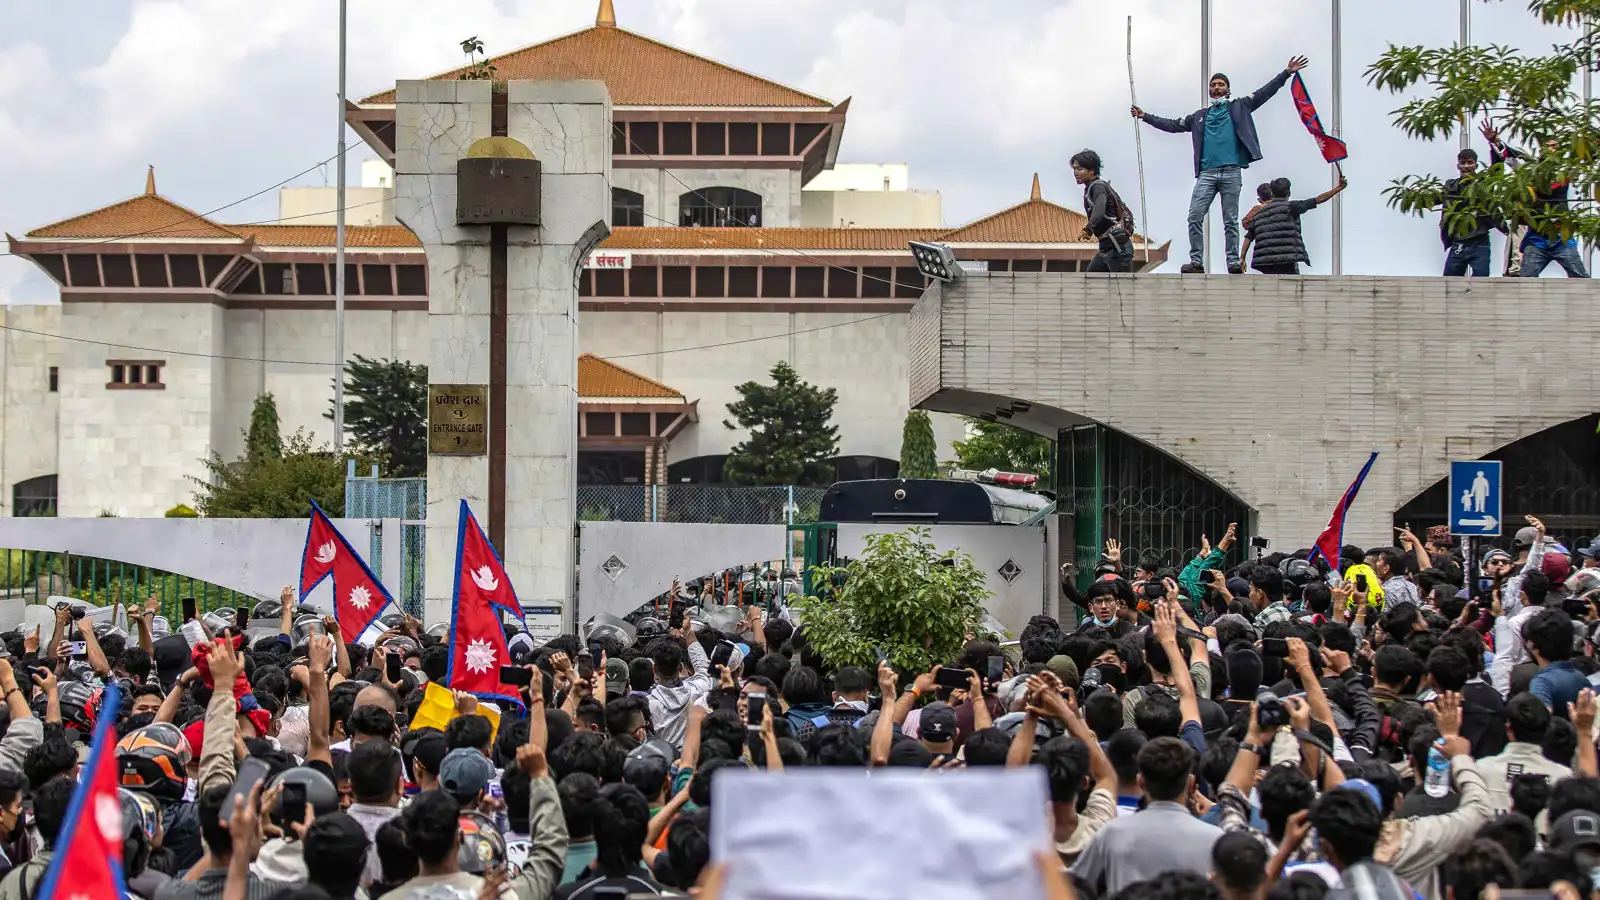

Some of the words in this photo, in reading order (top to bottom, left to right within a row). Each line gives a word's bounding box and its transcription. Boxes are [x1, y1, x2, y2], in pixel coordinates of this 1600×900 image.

[596, 252, 625, 267] संसद
[436, 393, 459, 405] प्रवेश
[463, 395, 481, 406] द्वार
[434, 424, 465, 432] ENTRANCE
[467, 424, 482, 432] GATE
[453, 436, 463, 445] 1
